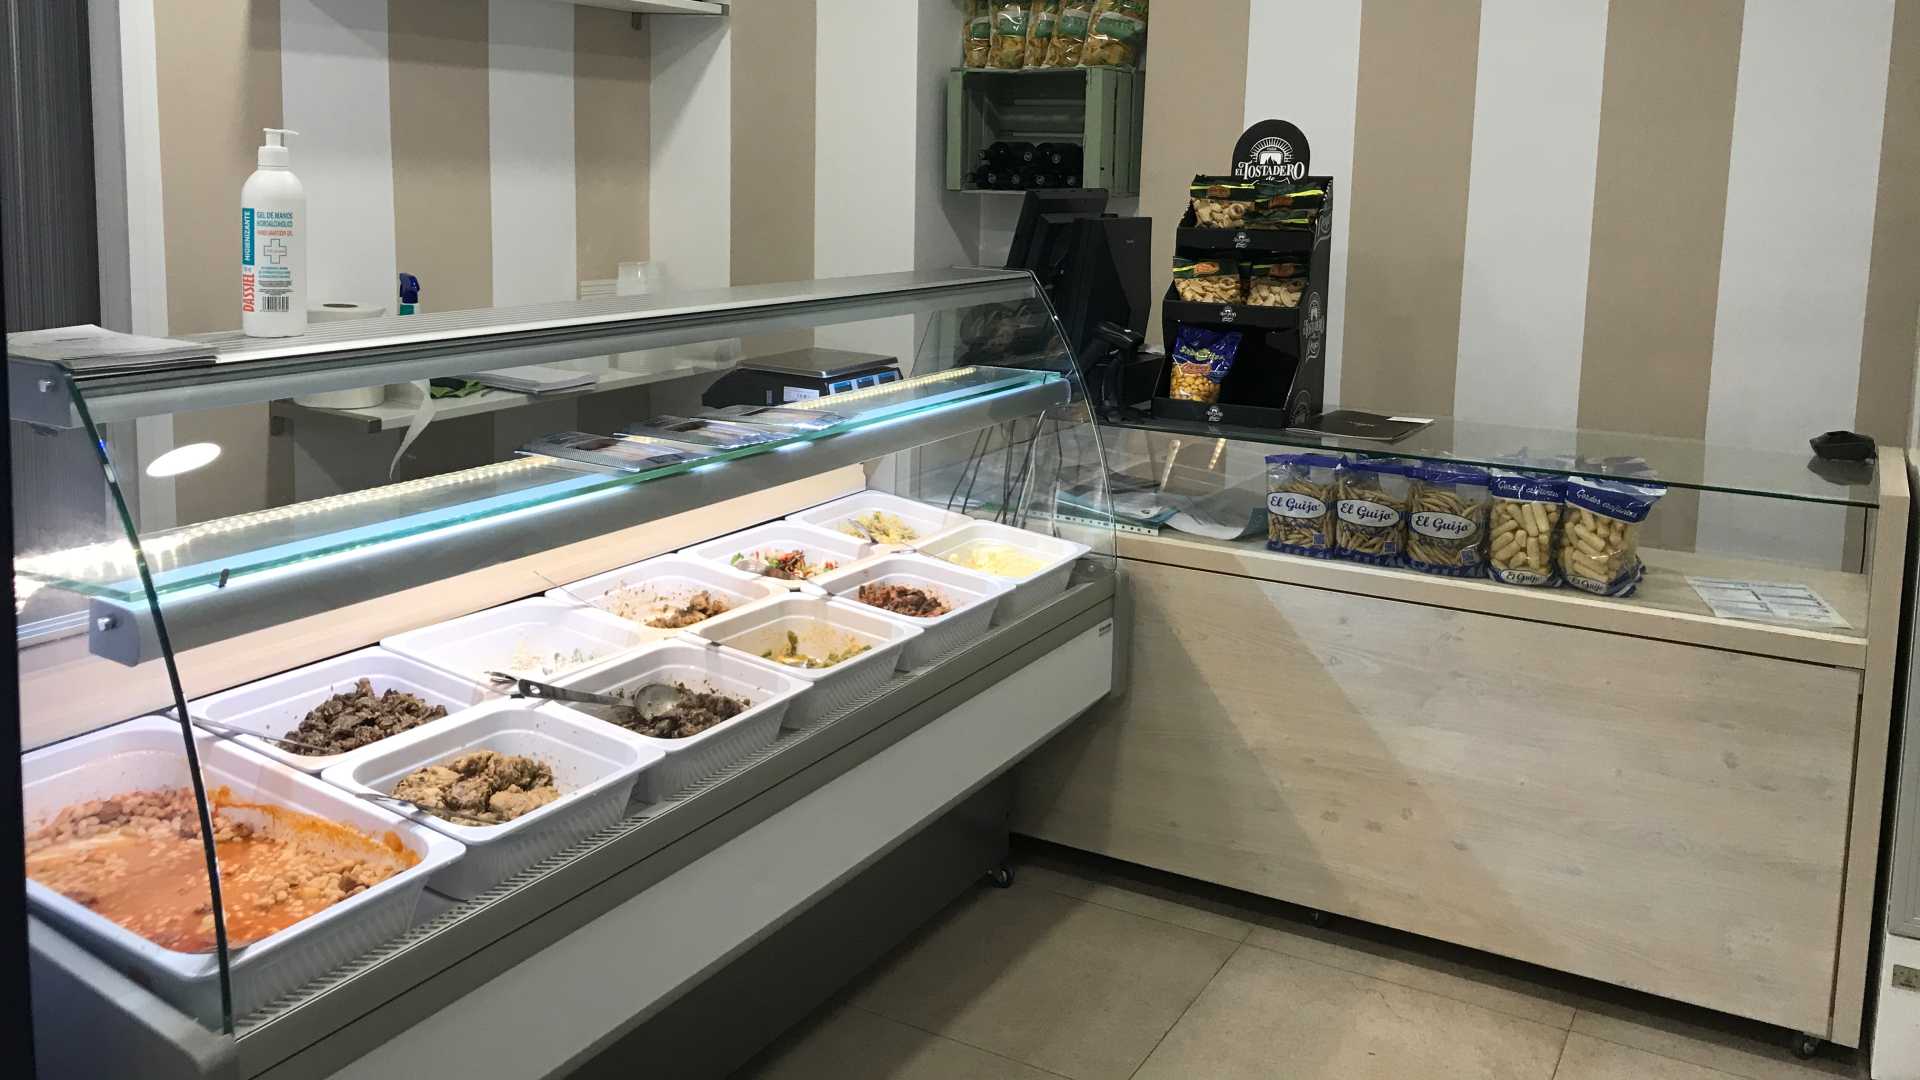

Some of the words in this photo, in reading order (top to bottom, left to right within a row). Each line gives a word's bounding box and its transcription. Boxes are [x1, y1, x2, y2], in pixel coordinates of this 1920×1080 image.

[1234, 168, 1243, 176] EL
[1238, 161, 1305, 180] TOSTADERO
[242, 273, 254, 312] DASSIEL
[1270, 496, 1283, 507] El
[1286, 498, 1318, 513] Guijo
[1340, 502, 1354, 514] El
[1357, 505, 1391, 522] Guijo
[1415, 515, 1429, 527] El
[1433, 518, 1468, 534] Guijo
